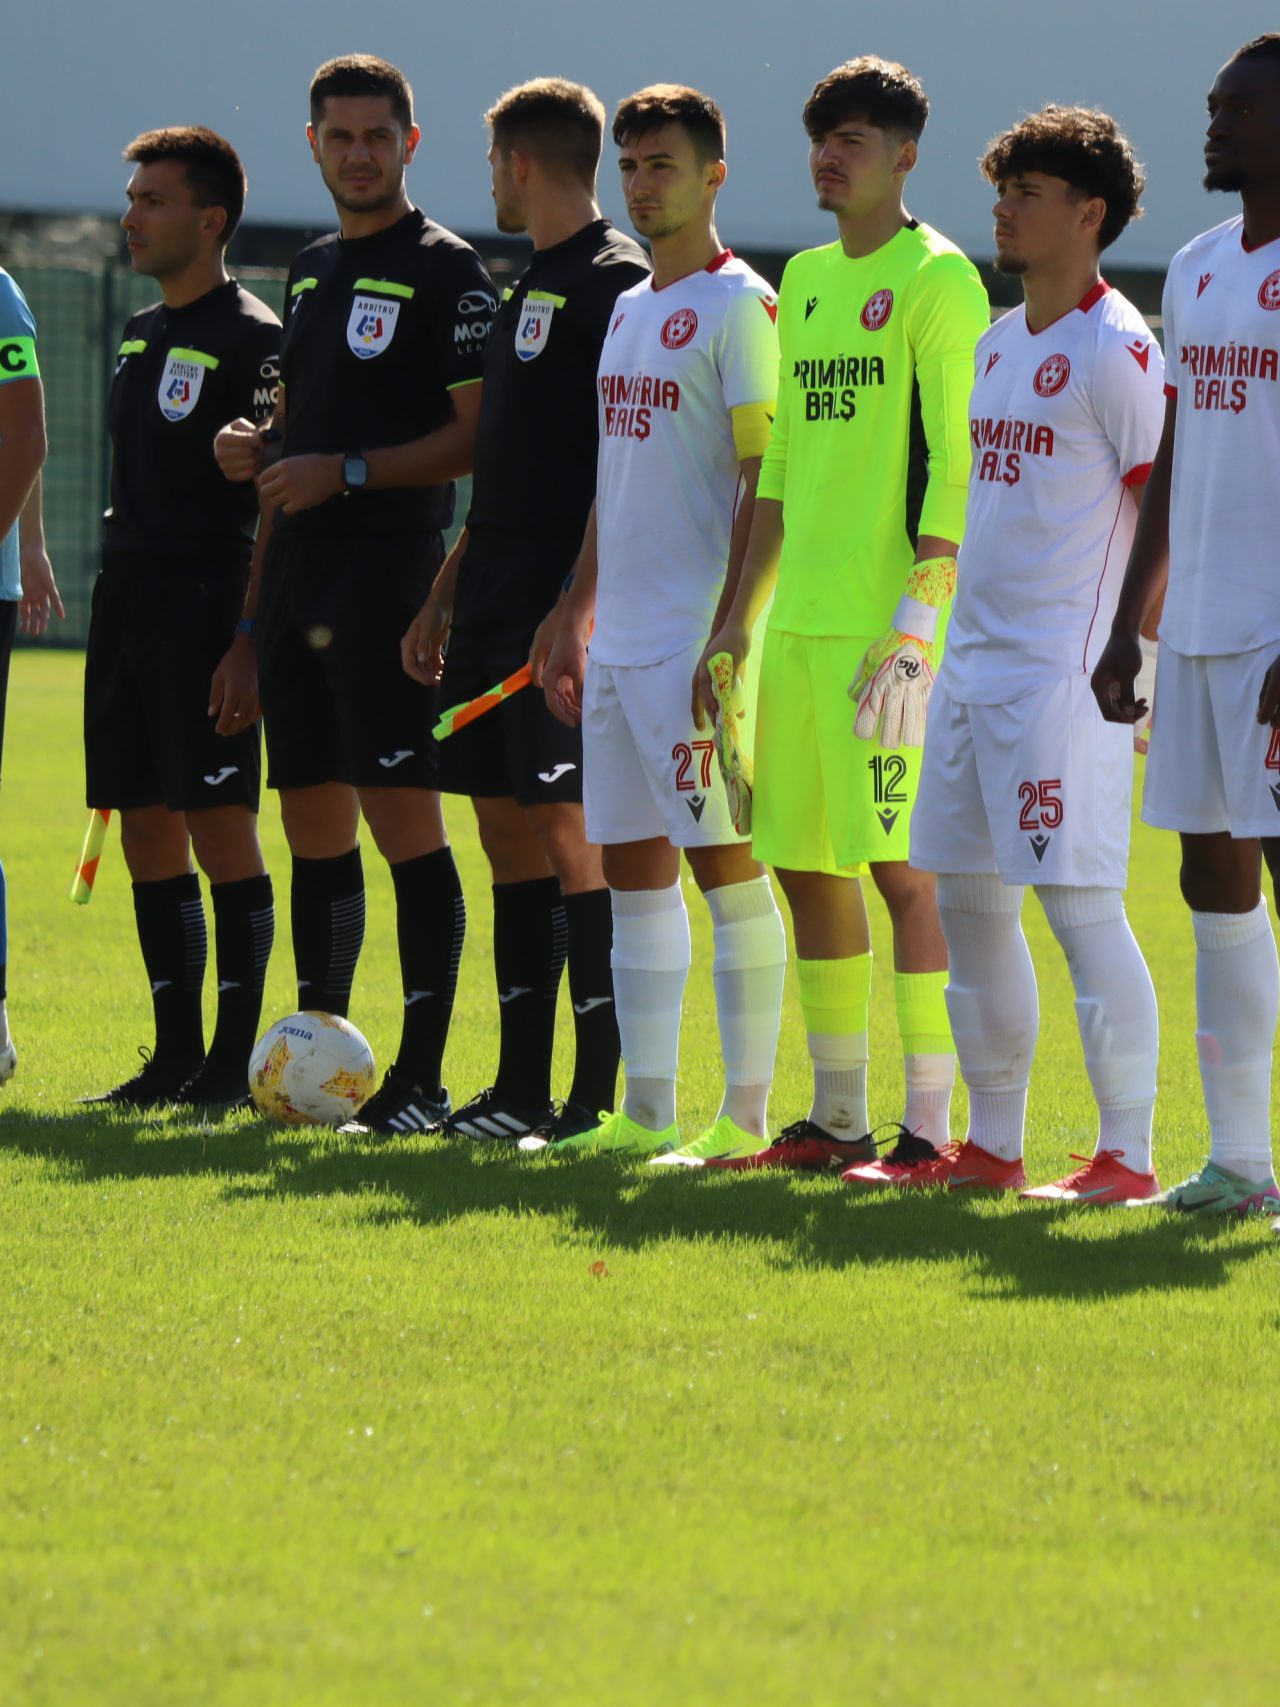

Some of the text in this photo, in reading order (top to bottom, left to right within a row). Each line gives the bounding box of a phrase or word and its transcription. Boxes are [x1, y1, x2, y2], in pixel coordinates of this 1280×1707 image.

[0, 342, 27, 373] C
[672, 739, 715, 792] 27
[867, 754, 908, 804] 12
[1018, 778, 1064, 831] 25
